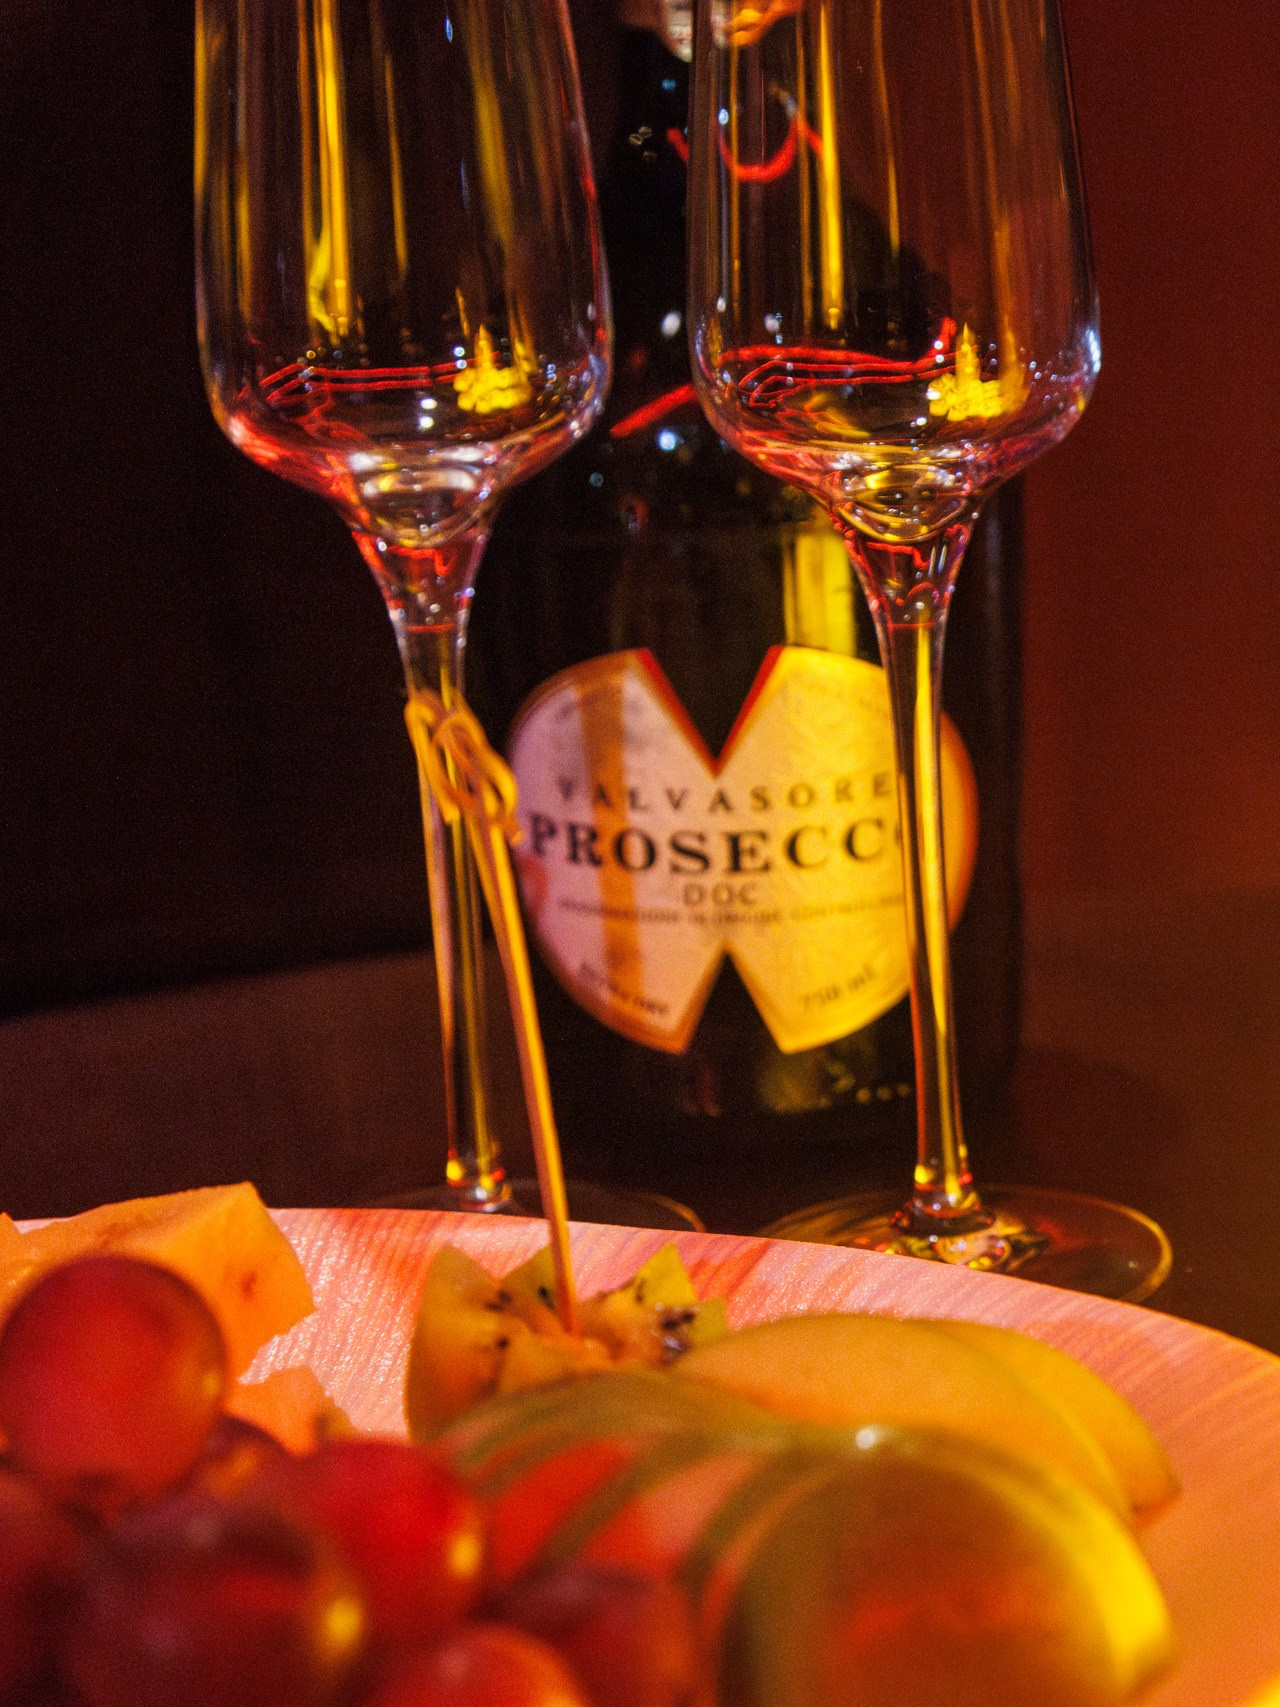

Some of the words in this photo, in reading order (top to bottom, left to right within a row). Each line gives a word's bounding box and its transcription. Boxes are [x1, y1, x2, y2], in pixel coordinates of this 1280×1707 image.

[557, 772, 892, 813] VALVASORE
[529, 812, 903, 875] PROSECC
[683, 882, 758, 907] DOC
